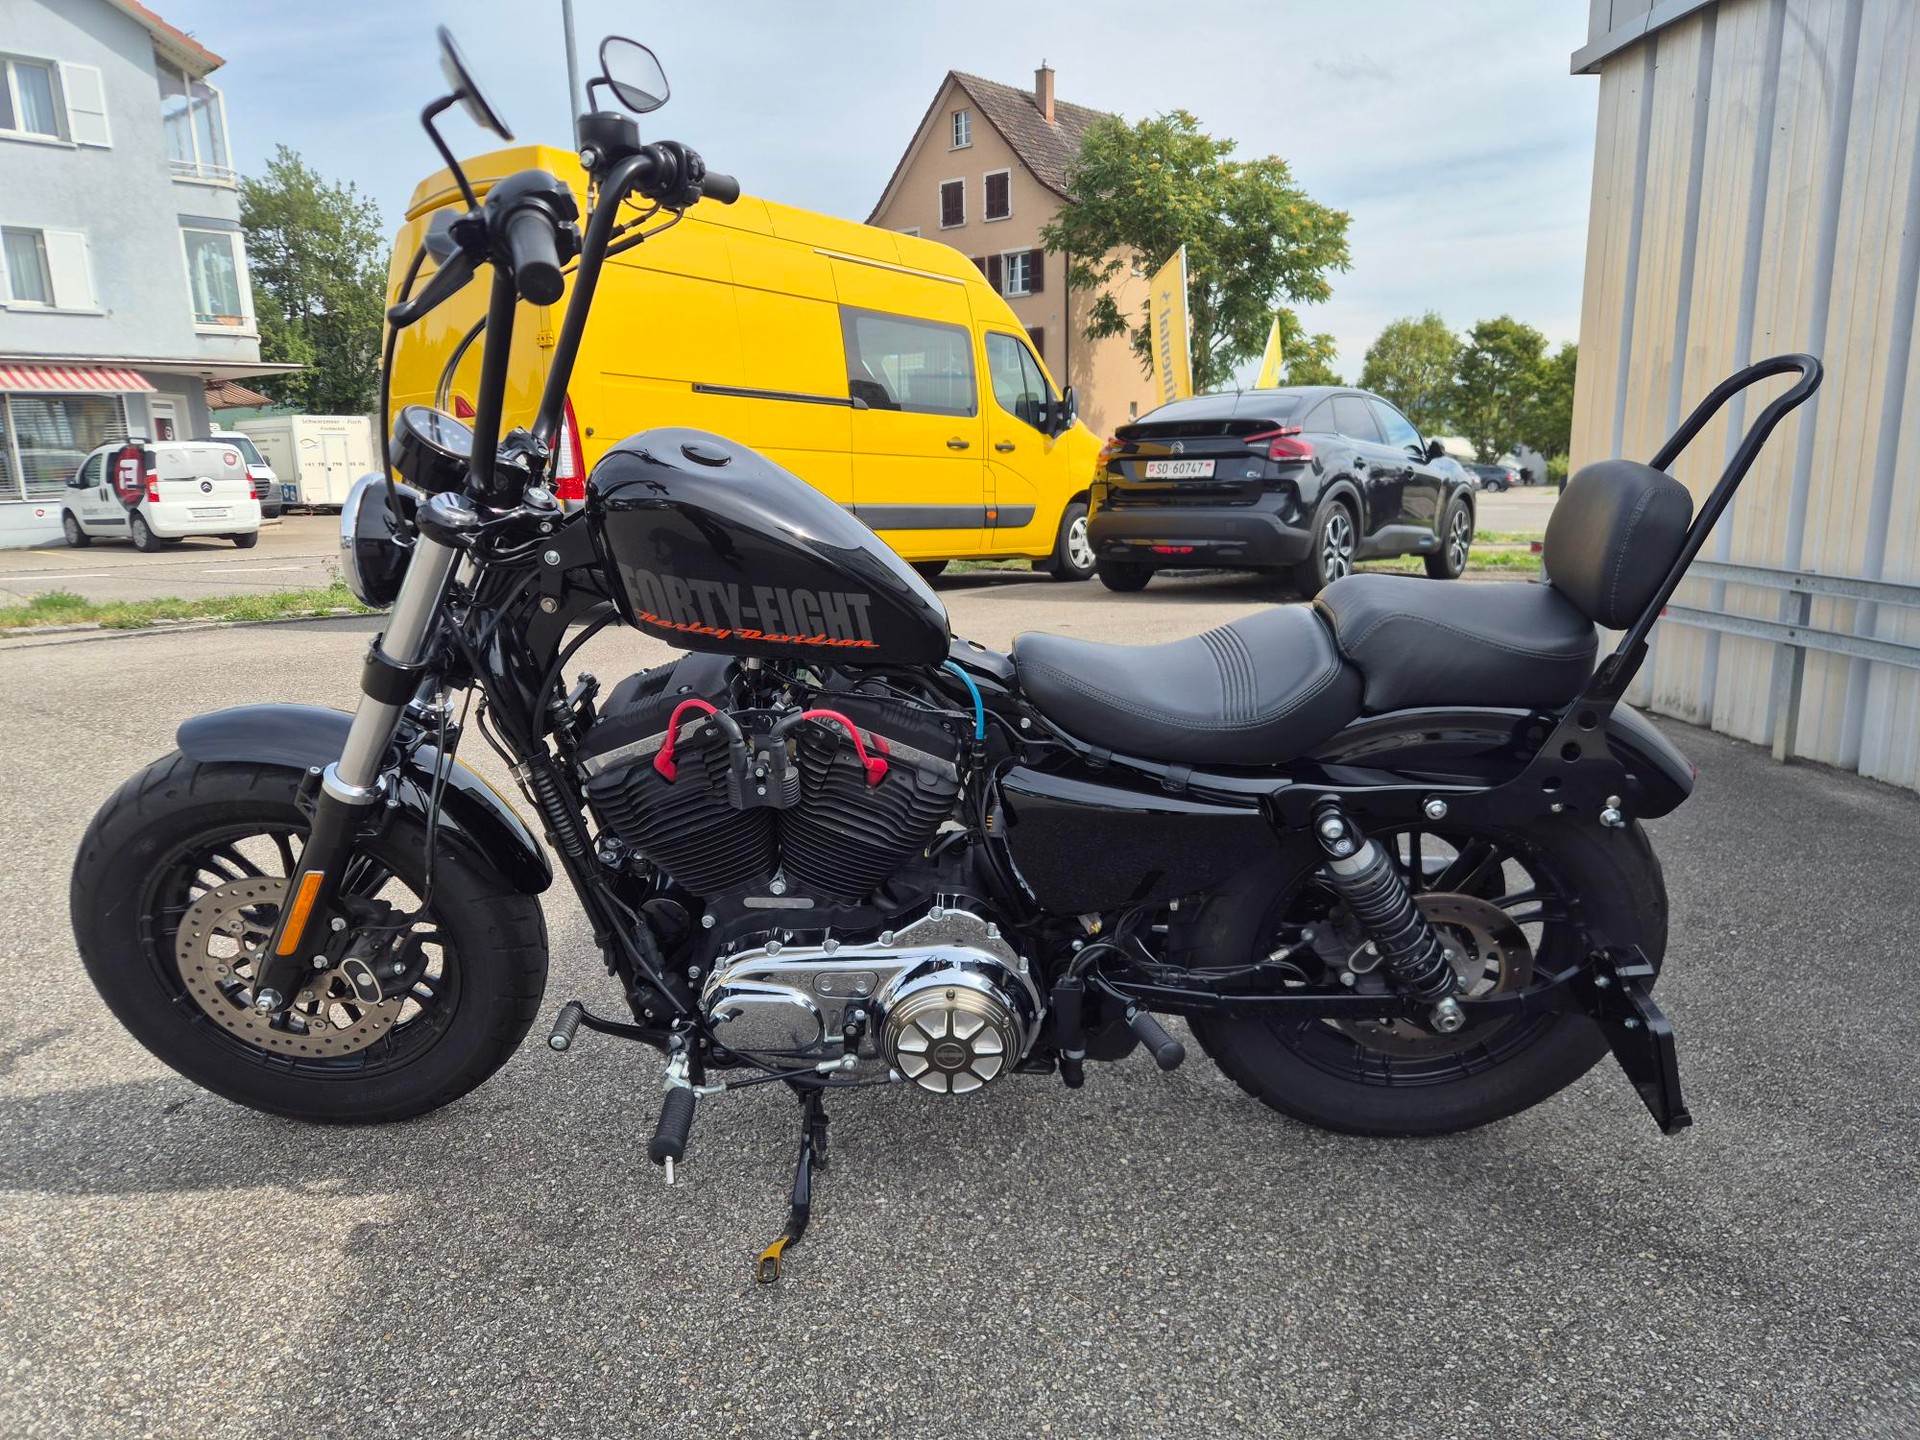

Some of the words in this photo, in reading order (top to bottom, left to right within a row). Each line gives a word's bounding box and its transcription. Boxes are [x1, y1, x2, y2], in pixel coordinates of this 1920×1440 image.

[1156, 463, 1168, 475] SO
[1173, 462, 1204, 475] 60747
[618, 561, 873, 642] FORTY-EIGHT
[636, 609, 880, 648] Harley-Davidson
